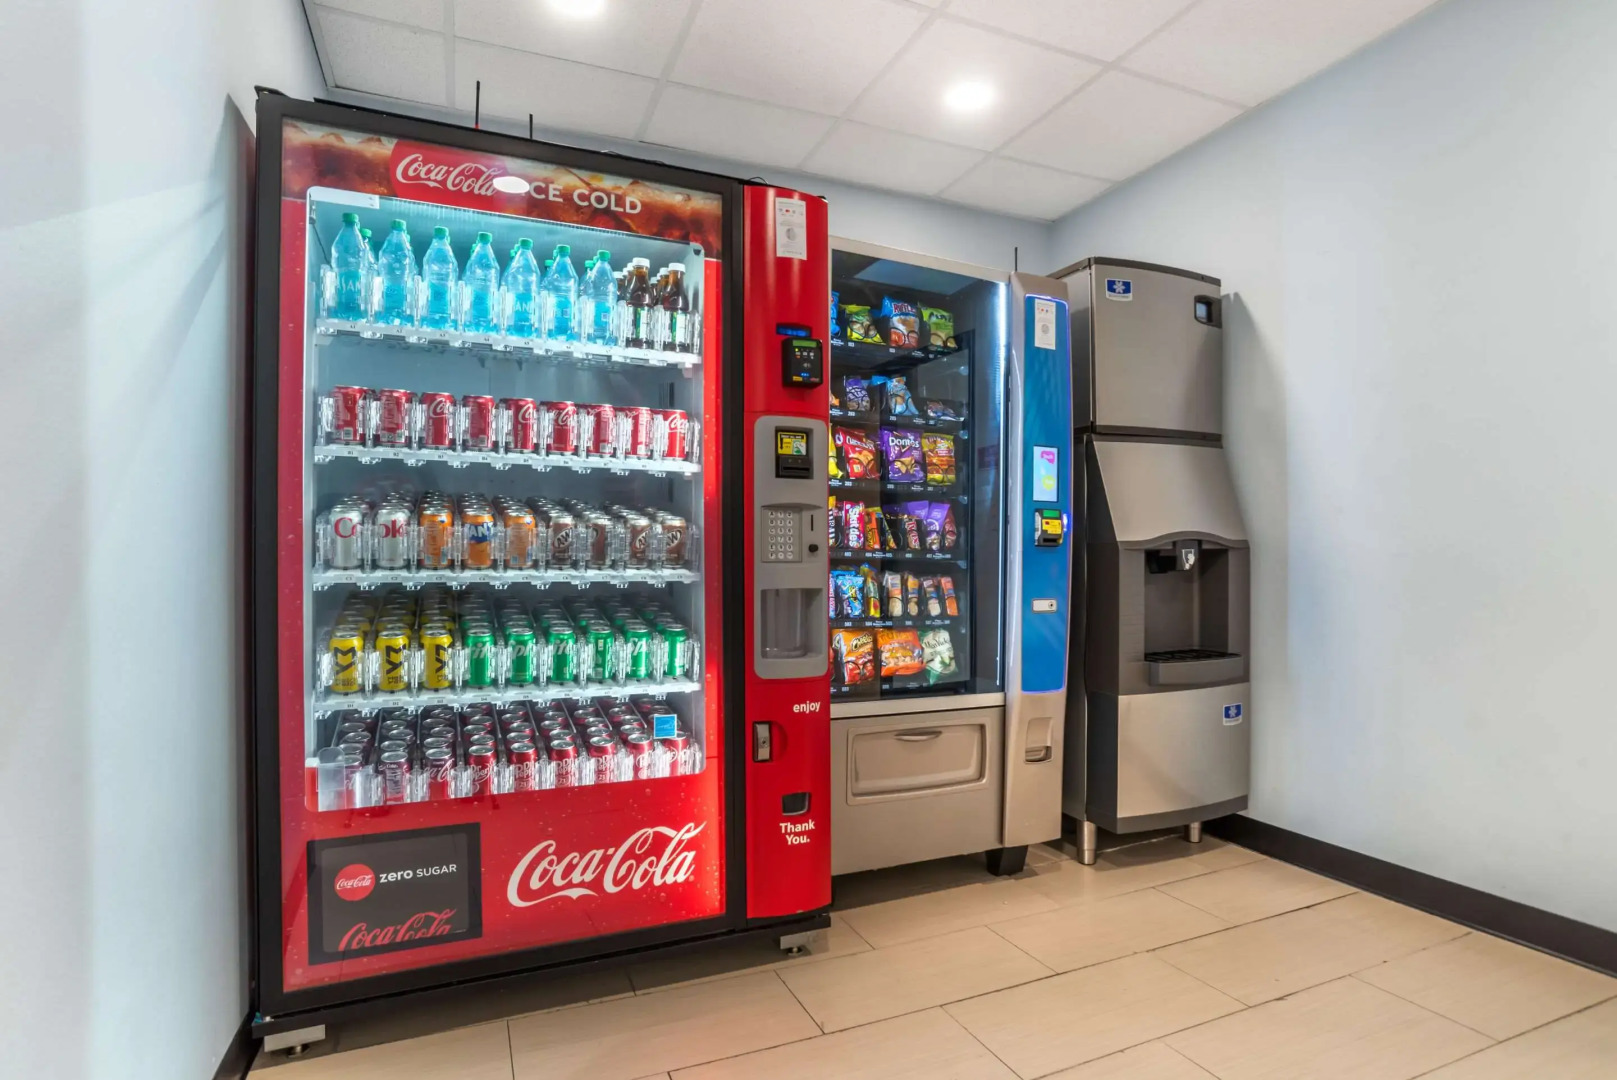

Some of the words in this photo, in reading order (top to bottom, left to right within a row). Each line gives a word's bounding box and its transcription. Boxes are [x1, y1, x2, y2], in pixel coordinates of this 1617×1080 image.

[396, 153, 503, 197] Coca-Cola
[523, 181, 564, 203] CE
[573, 188, 642, 214] COLD
[889, 434, 919, 448] Doritos
[793, 700, 821, 714] enjoy
[779, 819, 815, 834] Thank
[785, 834, 810, 845] You.
[507, 821, 707, 908] Coca-Cola
[336, 874, 373, 890] Coca-Cola
[379, 869, 413, 883] zero
[416, 864, 457, 878] SUGAR
